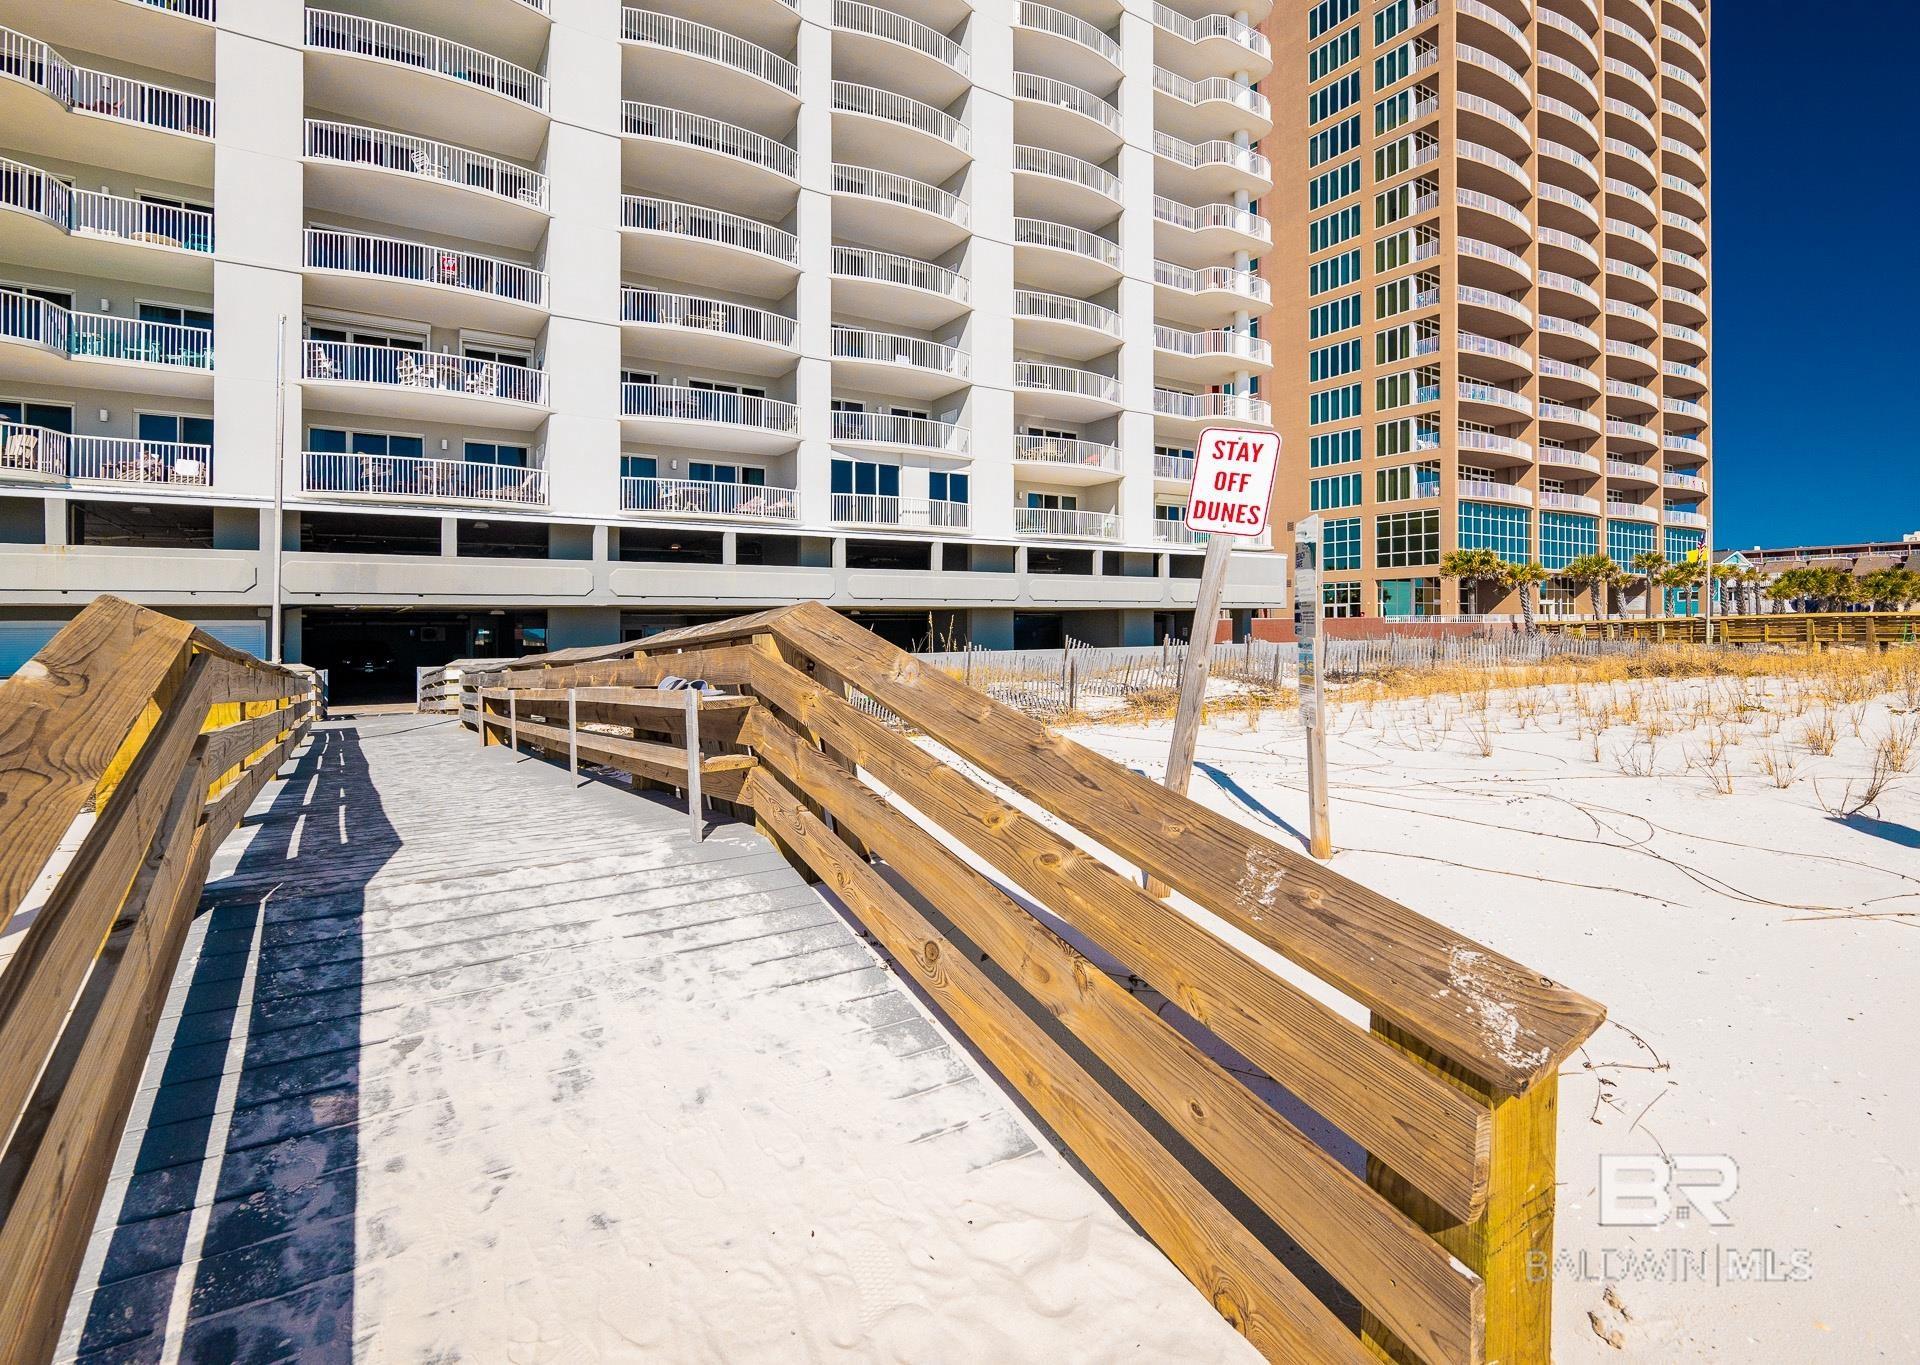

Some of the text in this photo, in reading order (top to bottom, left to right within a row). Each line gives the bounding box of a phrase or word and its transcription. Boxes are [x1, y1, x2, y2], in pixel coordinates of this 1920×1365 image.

[1212, 440, 1264, 462] STAY
[1213, 471, 1252, 492] OFF
[1193, 500, 1261, 525] DUNES
